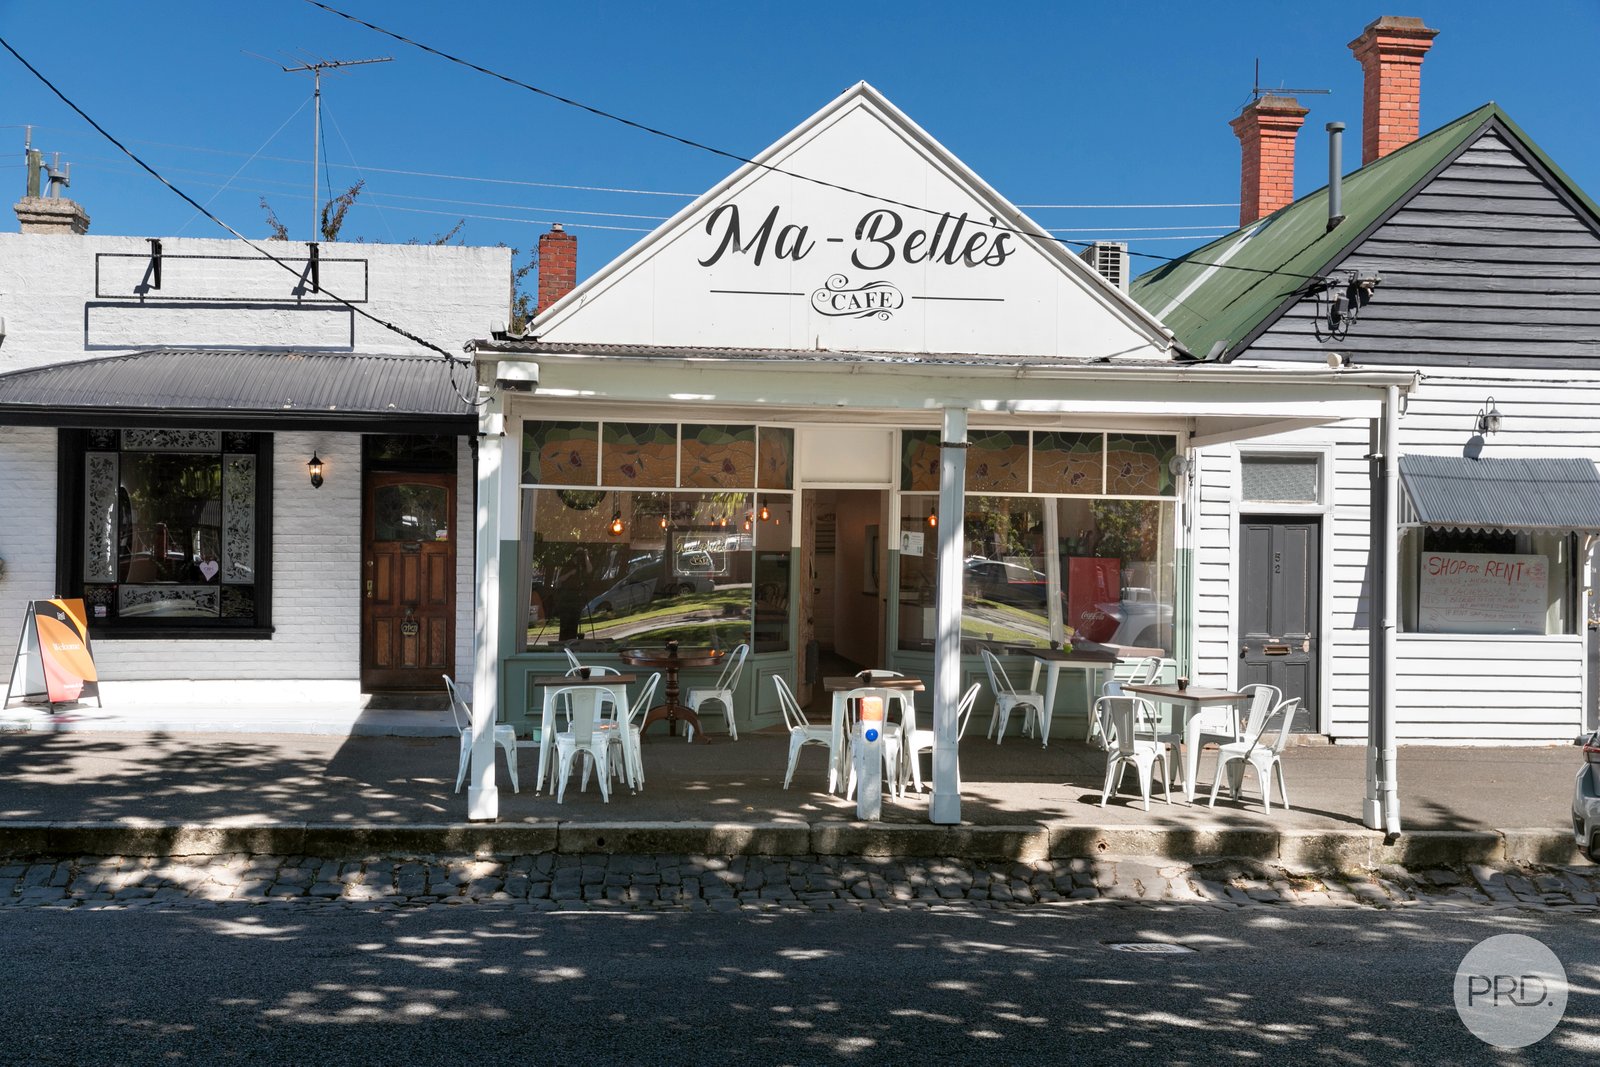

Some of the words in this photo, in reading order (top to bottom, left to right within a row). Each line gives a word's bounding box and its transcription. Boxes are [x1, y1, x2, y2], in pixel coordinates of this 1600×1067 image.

[831, 292, 893, 311] CAFE
[1428, 556, 1467, 576] SHOP
[1467, 564, 1480, 574] FOR
[1484, 560, 1525, 586] RENT
[53, 642, 80, 651] Welcome
